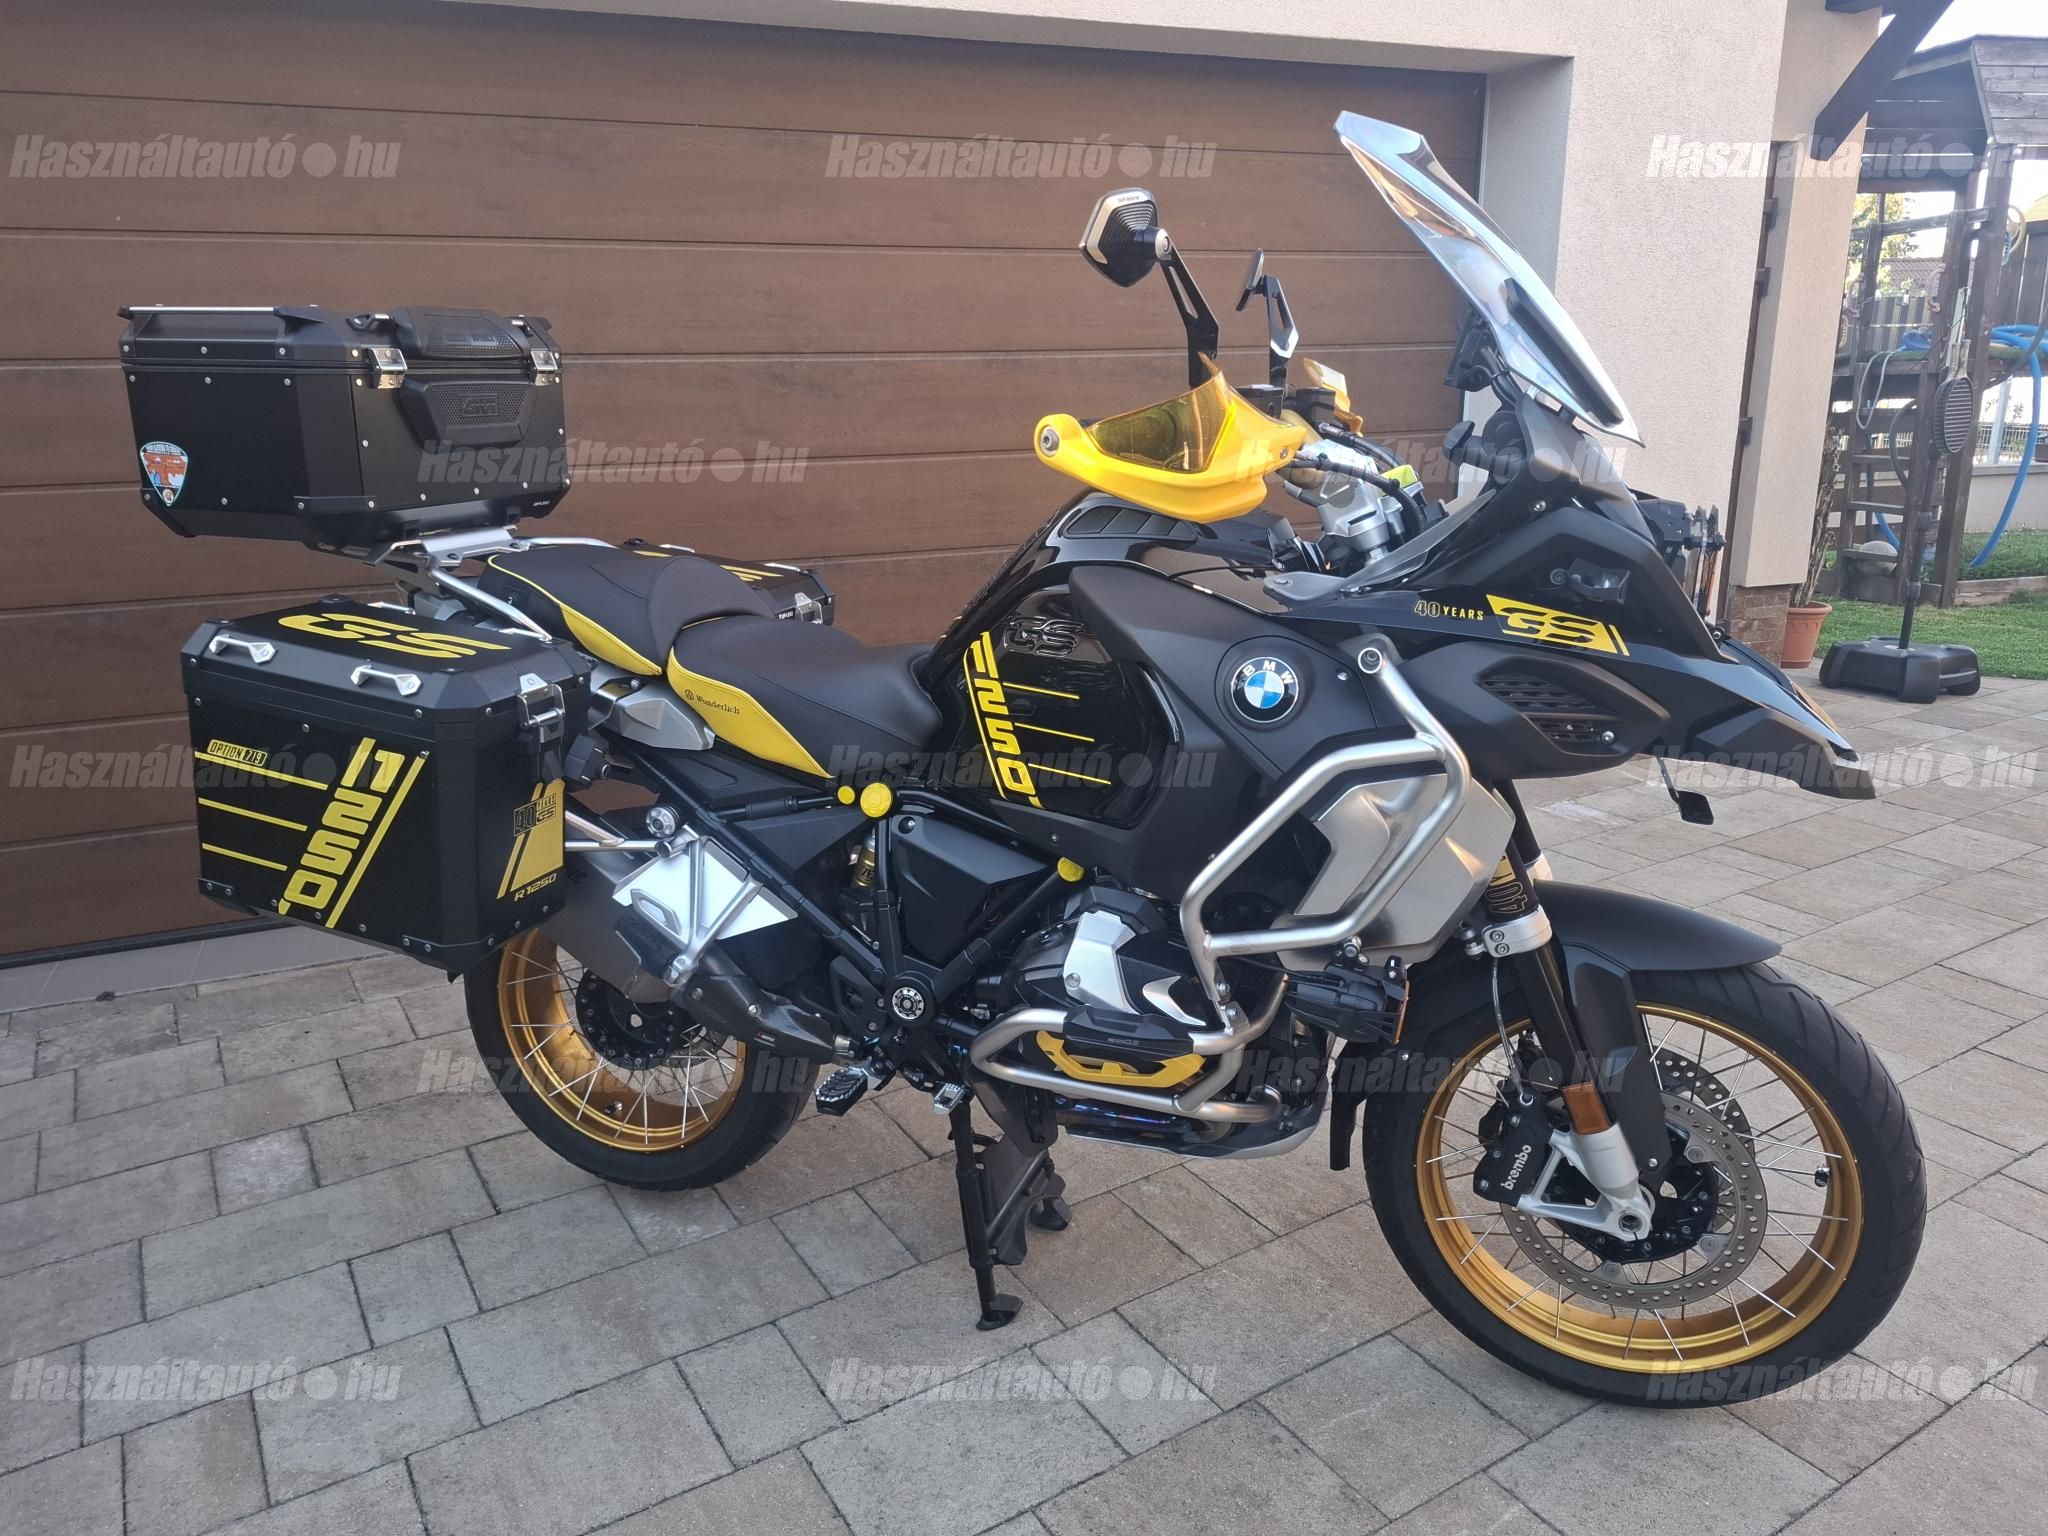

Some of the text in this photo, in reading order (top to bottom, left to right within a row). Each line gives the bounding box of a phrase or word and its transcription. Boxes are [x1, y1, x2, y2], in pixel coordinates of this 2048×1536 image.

[278, 613, 512, 658] GS
[1414, 599, 1599, 645] 40 YEARS GS
[1242, 659, 1294, 684] BMW
[695, 694, 740, 715] Wunderlich
[209, 741, 262, 764] OPTION 719
[1500, 1144, 1532, 1191] brembo
